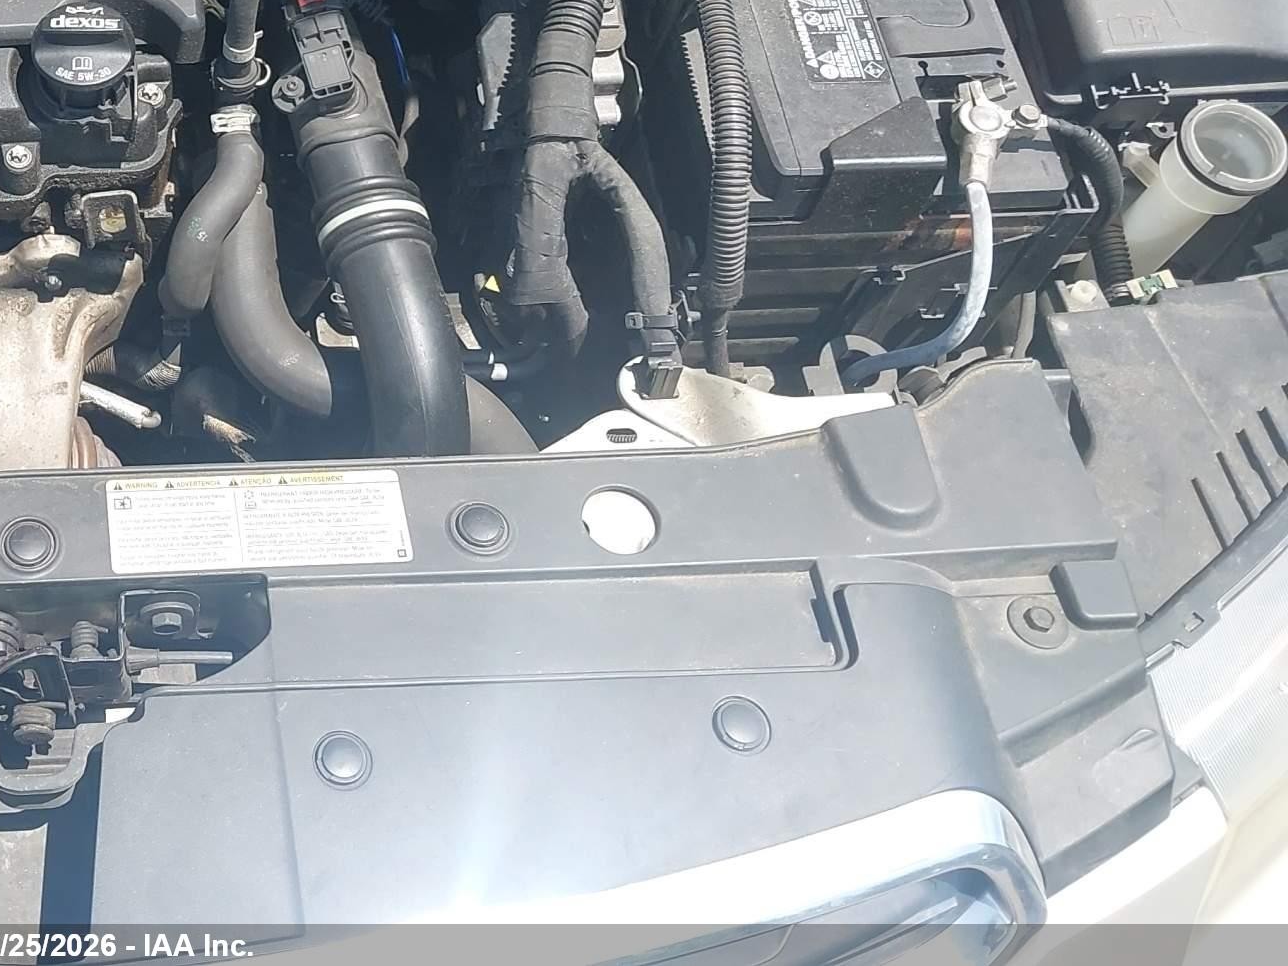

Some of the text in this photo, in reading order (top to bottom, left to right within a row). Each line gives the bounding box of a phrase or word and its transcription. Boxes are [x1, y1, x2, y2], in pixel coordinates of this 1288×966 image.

[50, 14, 120, 29] dexos
[55, 66, 112, 81] SAE 5W-30
